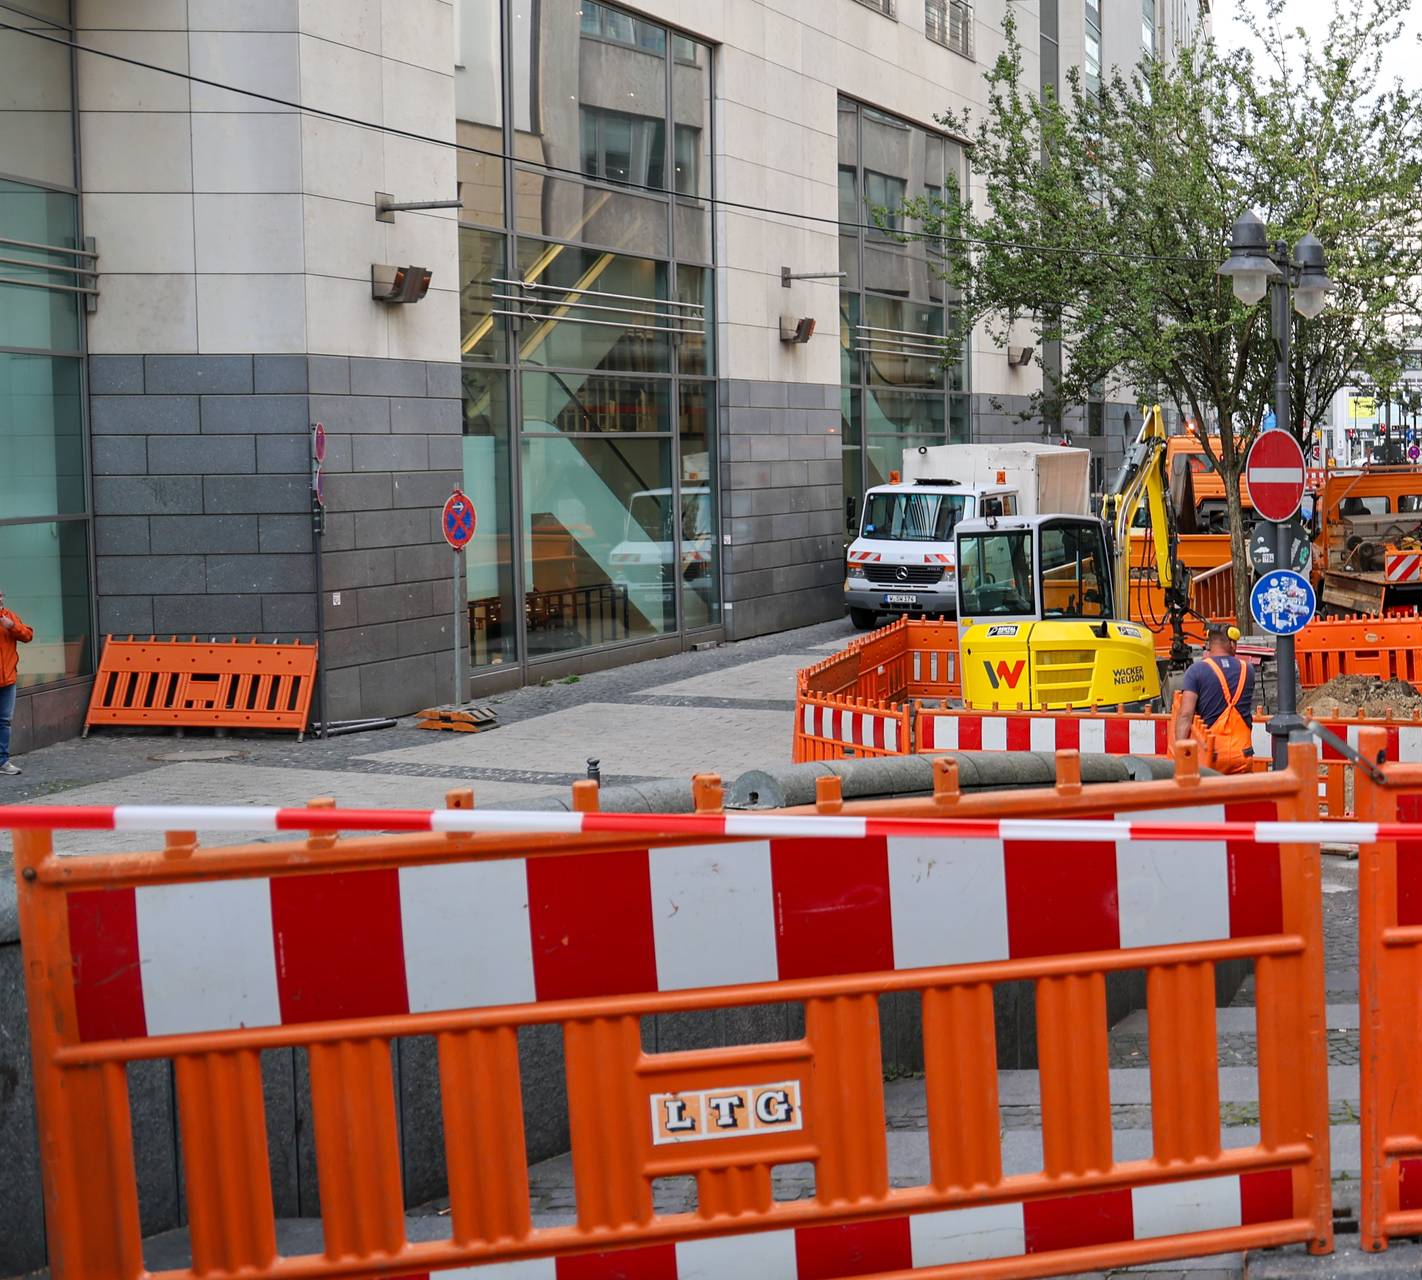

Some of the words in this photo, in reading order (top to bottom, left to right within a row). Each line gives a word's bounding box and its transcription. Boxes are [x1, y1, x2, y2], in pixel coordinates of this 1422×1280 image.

[1113, 666, 1143, 677] WACKER
[1114, 674, 1145, 685] NEUSON
[664, 1091, 792, 1131] LTG
